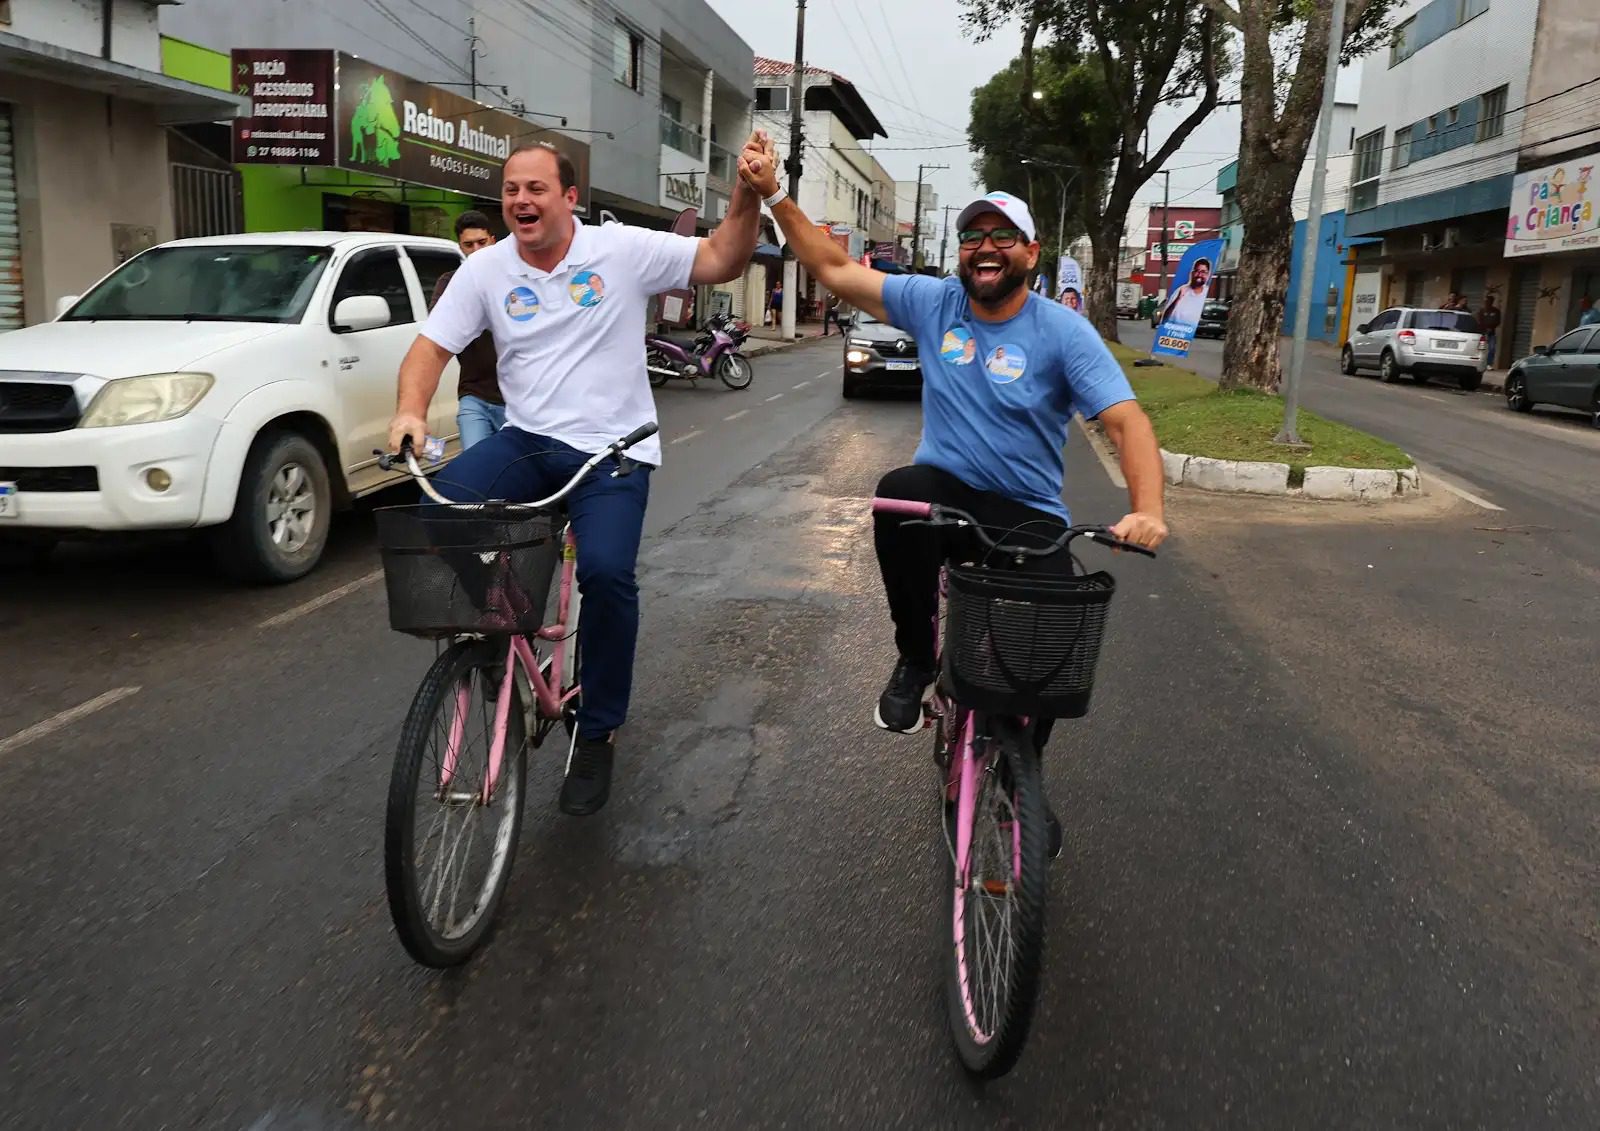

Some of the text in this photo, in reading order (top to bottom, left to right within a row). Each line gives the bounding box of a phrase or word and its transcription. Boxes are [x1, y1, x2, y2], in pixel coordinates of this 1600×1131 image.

[253, 59, 286, 79] RAÇÃO
[253, 80, 315, 97] ACESSÓRIOS
[253, 101, 329, 118] AGROPECUÁRIA
[403, 100, 511, 160] Reino Animal
[258, 147, 271, 157] 27
[430, 154, 490, 181] RAÇÕES E AGRO
[1526, 201, 1593, 231] Criança
